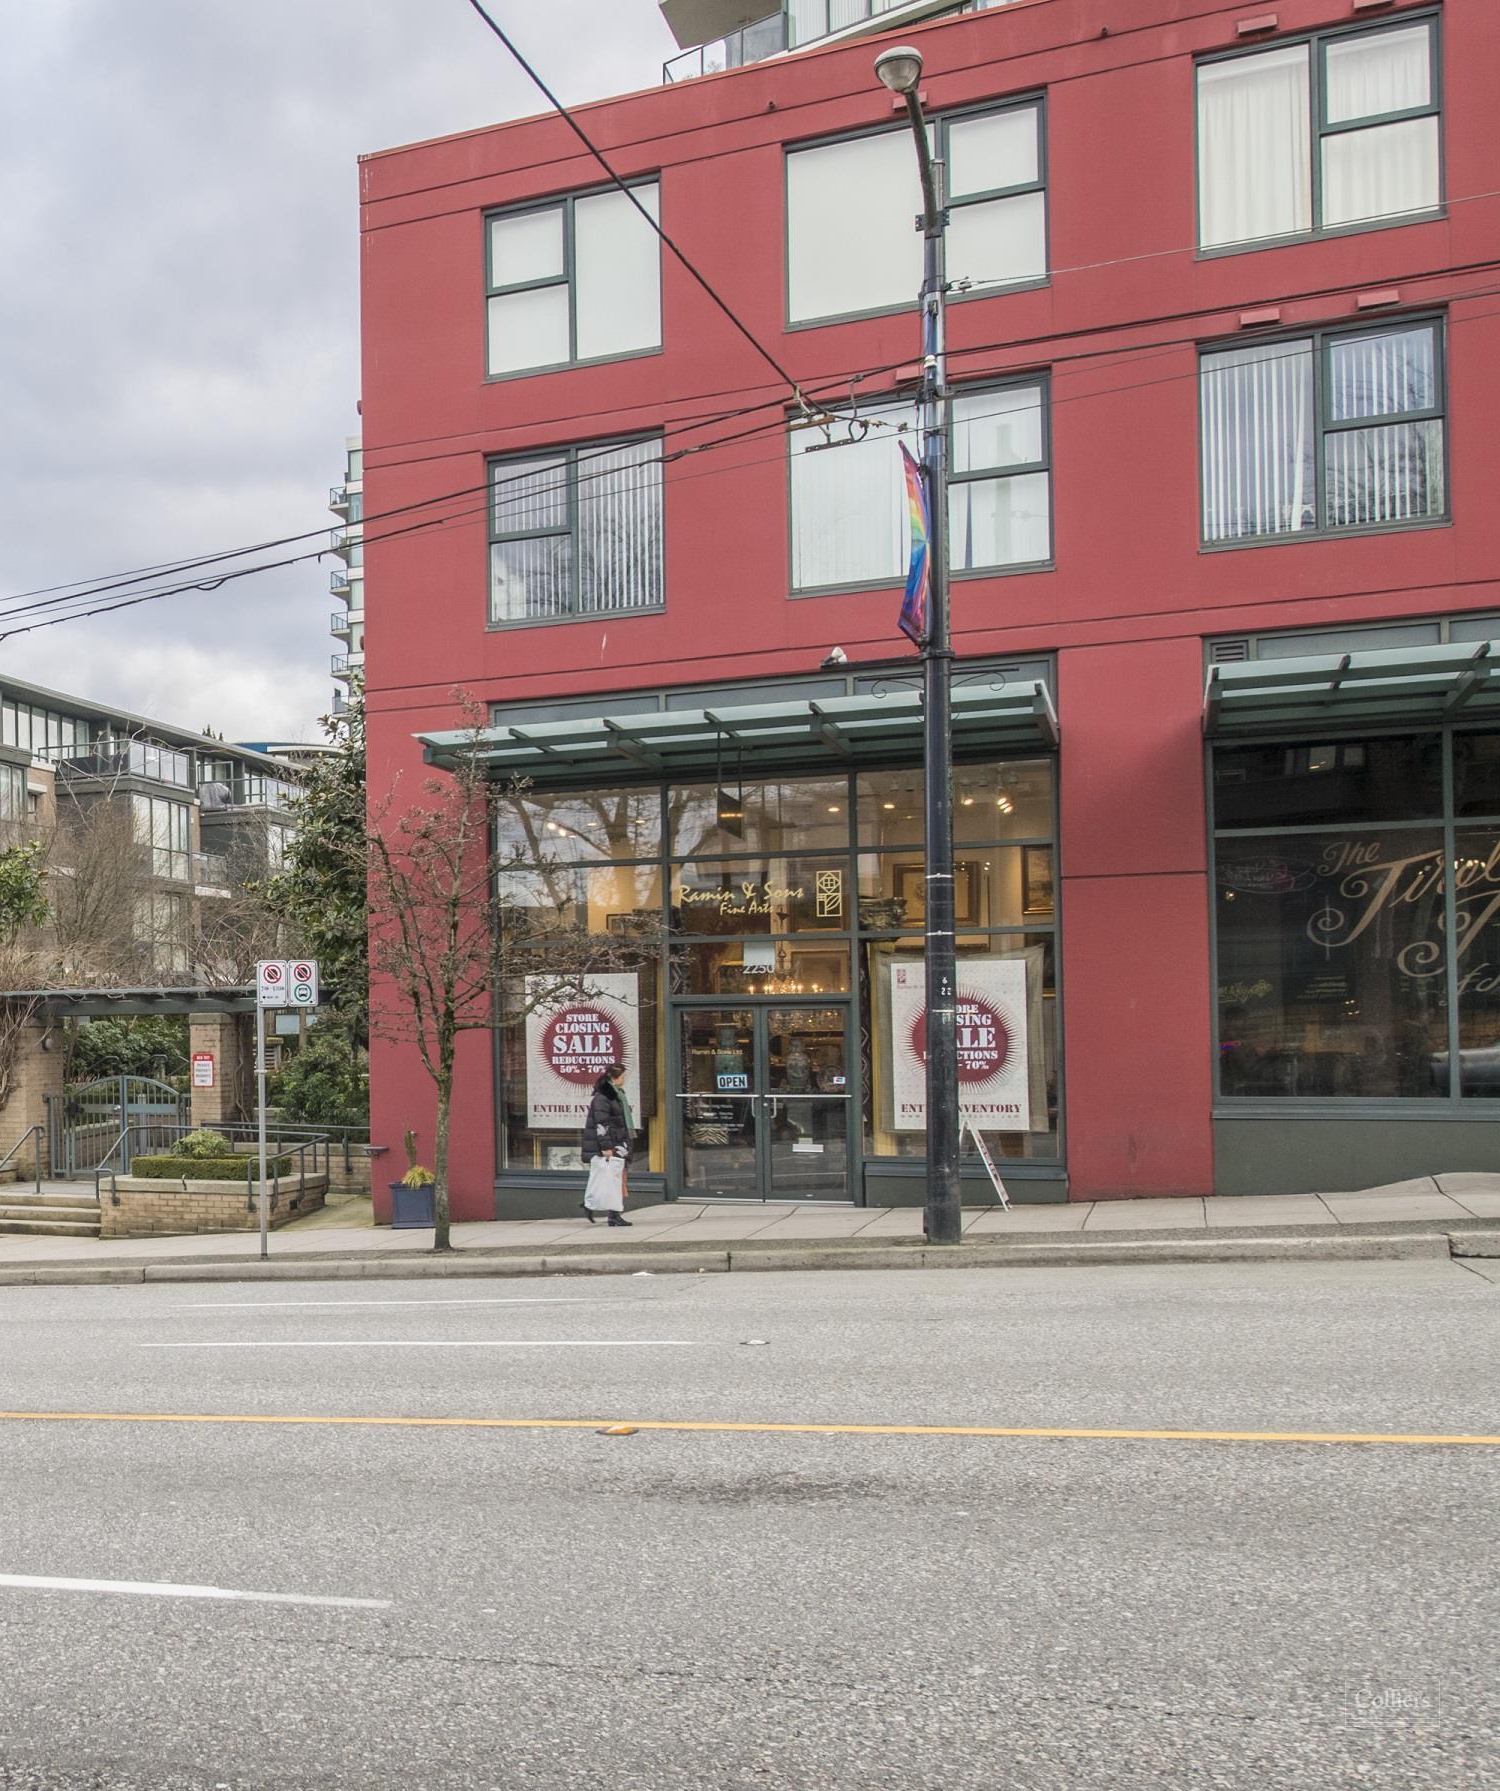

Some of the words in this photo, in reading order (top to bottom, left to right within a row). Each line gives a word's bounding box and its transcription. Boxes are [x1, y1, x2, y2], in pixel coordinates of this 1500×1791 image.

[1316, 842, 1381, 876] The
[679, 885, 736, 902] Ramin
[742, 882, 756, 899] &
[764, 880, 804, 900] Sons
[720, 902, 745, 915] Fine
[748, 901, 773, 915] Arts
[956, 1004, 979, 1013] ORE
[566, 1014, 598, 1022] STORE
[956, 1014, 992, 1025] SING
[555, 1023, 609, 1033] CLOSING
[956, 1028, 996, 1048] LE
[553, 1035, 613, 1054] SALE
[552, 1056, 615, 1064] REDUCTIONS
[587, 1065, 606, 1073] 70%
[965, 1061, 989, 1070] 70%
[719, 1076, 746, 1088] OPEN
[533, 1104, 572, 1113] ENTIRE
[901, 1104, 925, 1113] ENT
[958, 1104, 1021, 1113] NVENTORY
